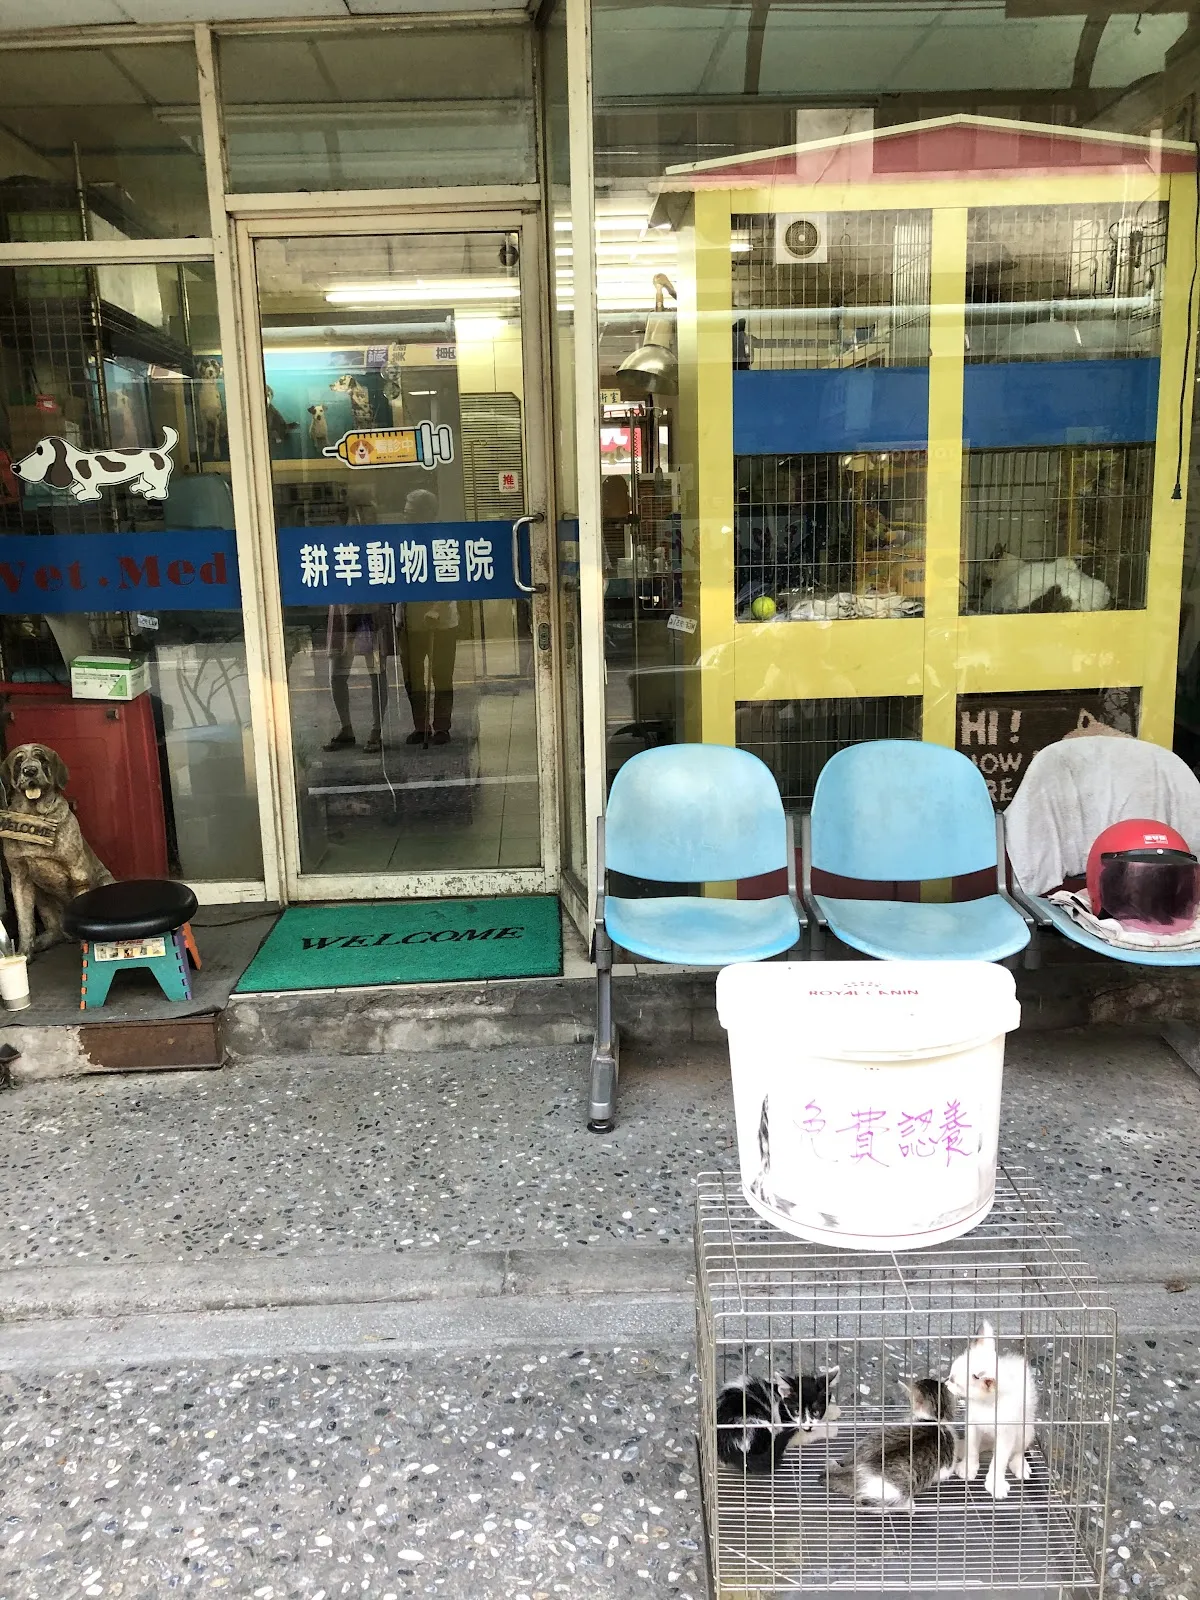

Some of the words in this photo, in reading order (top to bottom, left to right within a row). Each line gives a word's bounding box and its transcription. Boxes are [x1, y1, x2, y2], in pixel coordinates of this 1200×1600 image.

[503, 474, 515, 486] 推
[300, 537, 494, 588] 耕莘動物醫院
[987, 777, 1014, 802] RE
[302, 926, 525, 950] WELCOME
[793, 1099, 973, 1167] 免費認養
